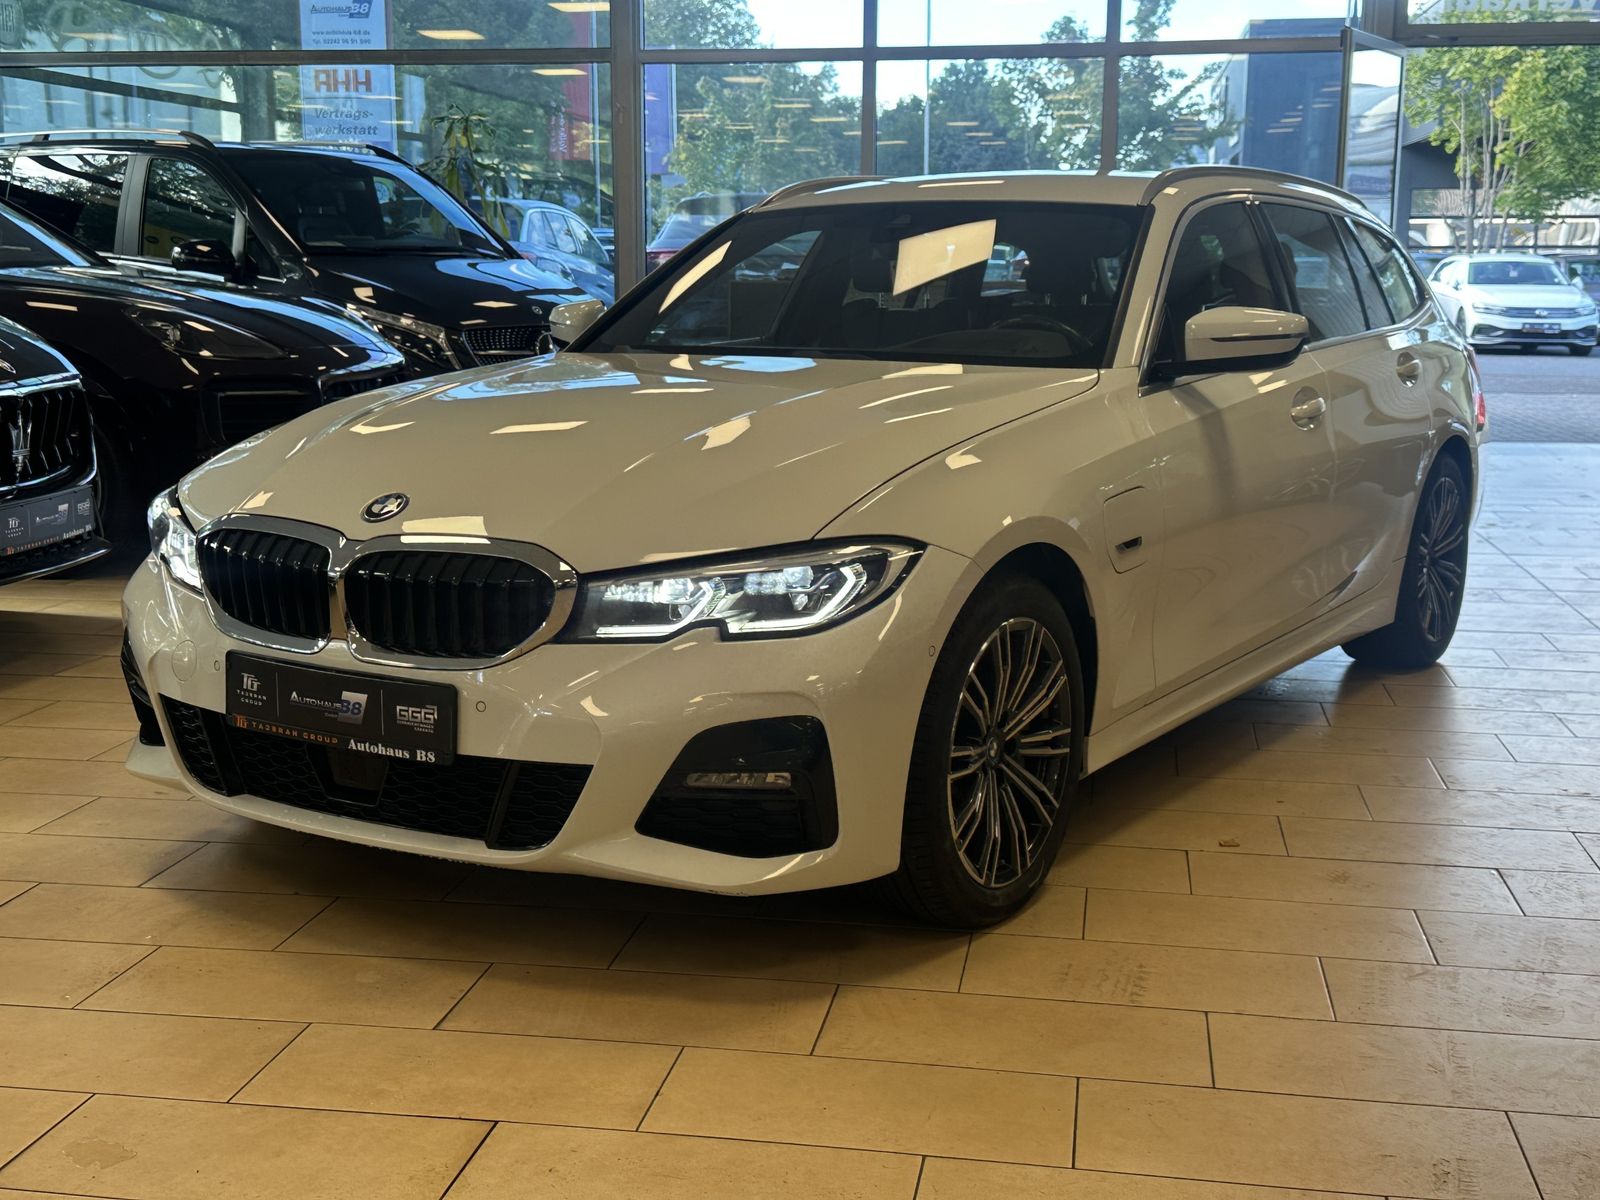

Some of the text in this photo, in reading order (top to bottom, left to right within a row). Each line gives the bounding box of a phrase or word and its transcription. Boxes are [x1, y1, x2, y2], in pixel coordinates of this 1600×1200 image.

[314, 69, 373, 93] AHH
[315, 109, 374, 120] Vertrags-
[314, 125, 378, 136] werkstatt
[348, 738, 436, 763] Autohaus B8
